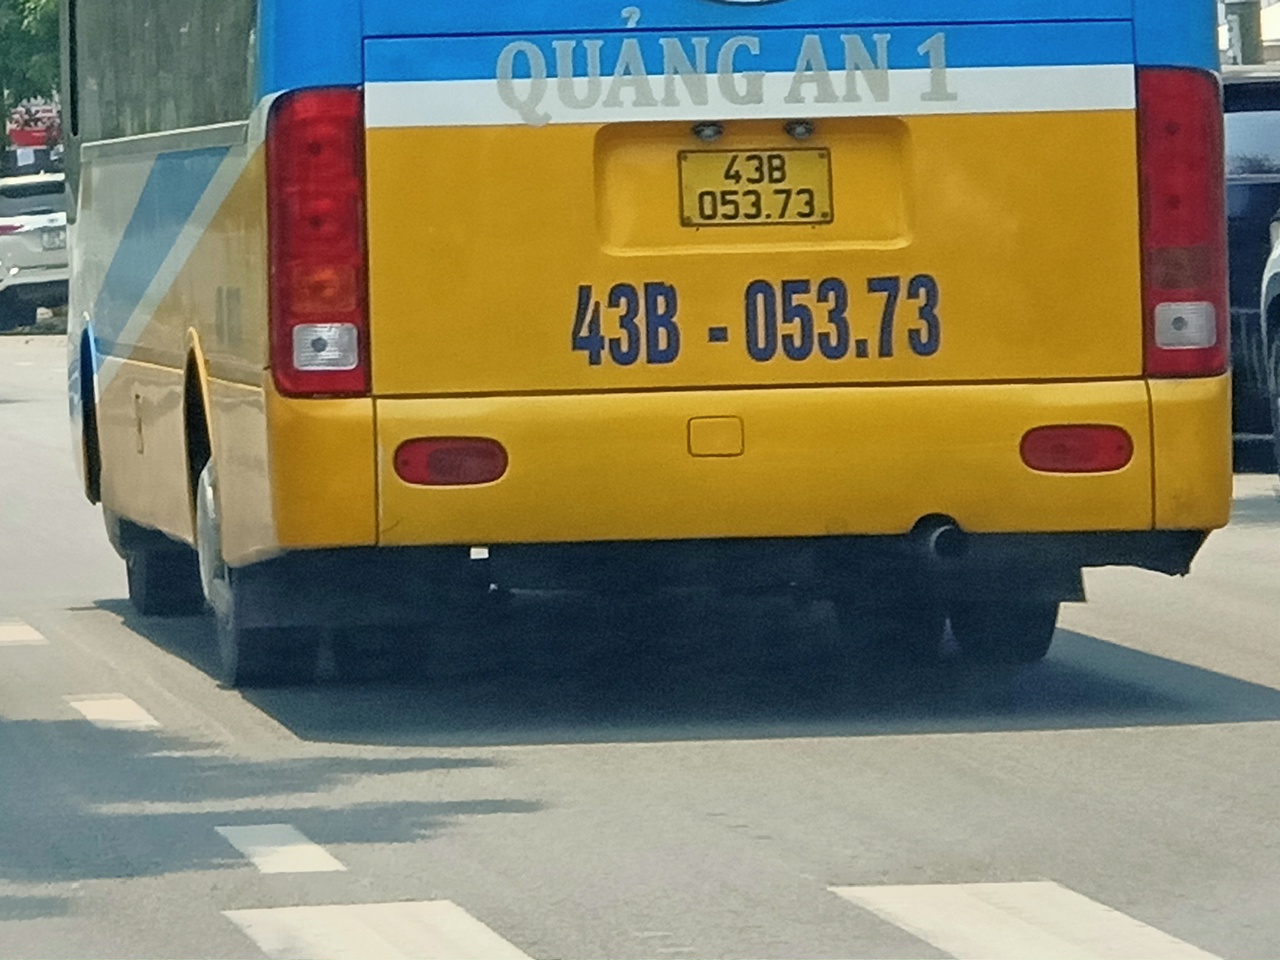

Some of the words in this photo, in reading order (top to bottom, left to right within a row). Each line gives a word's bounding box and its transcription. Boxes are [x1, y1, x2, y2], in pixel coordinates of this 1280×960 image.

[495, 6, 767, 127] QUẢNG
[784, 33, 892, 104] AN
[917, 33, 958, 102] 1
[723, 153, 787, 185] 43B
[698, 188, 816, 221] 053.73
[572, 281, 681, 366] 43B
[743, 273, 941, 362] 053.73
